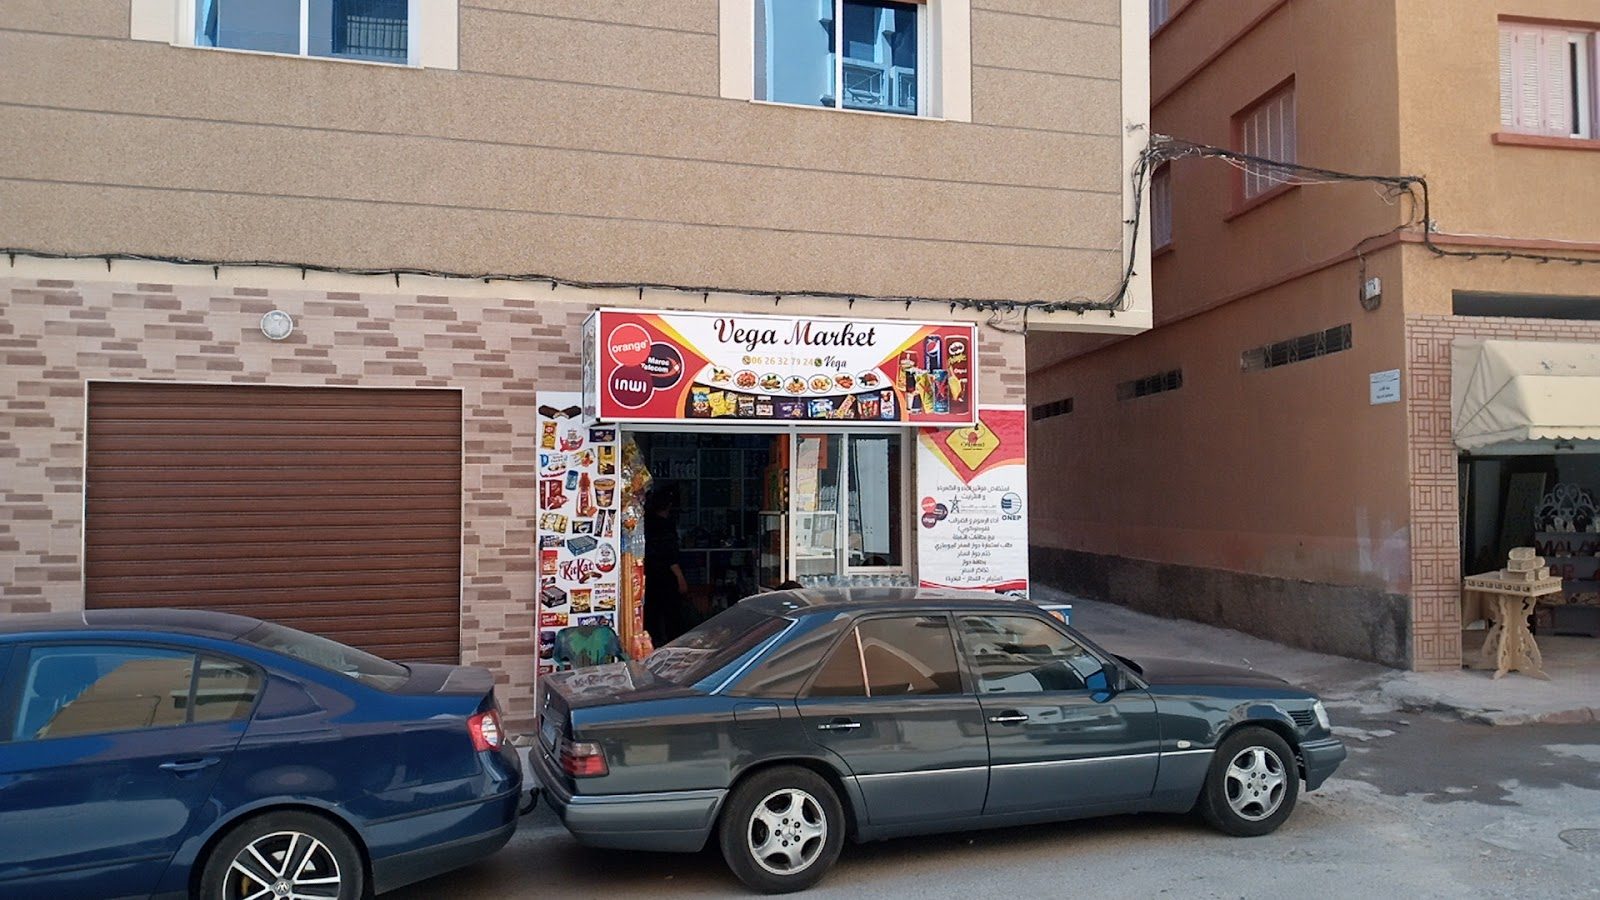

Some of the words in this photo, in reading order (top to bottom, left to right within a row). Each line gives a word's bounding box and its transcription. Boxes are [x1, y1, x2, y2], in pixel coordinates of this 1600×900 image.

[714, 318, 778, 352] Vega
[784, 320, 876, 347] Market
[612, 341, 646, 353] orange
[641, 362, 669, 373] Telecom
[648, 357, 670, 366] Maroc
[751, 356, 763, 365] 06
[764, 357, 776, 365] 26
[777, 357, 788, 366] 32
[802, 358, 814, 366] 24
[824, 355, 847, 371] Vega
